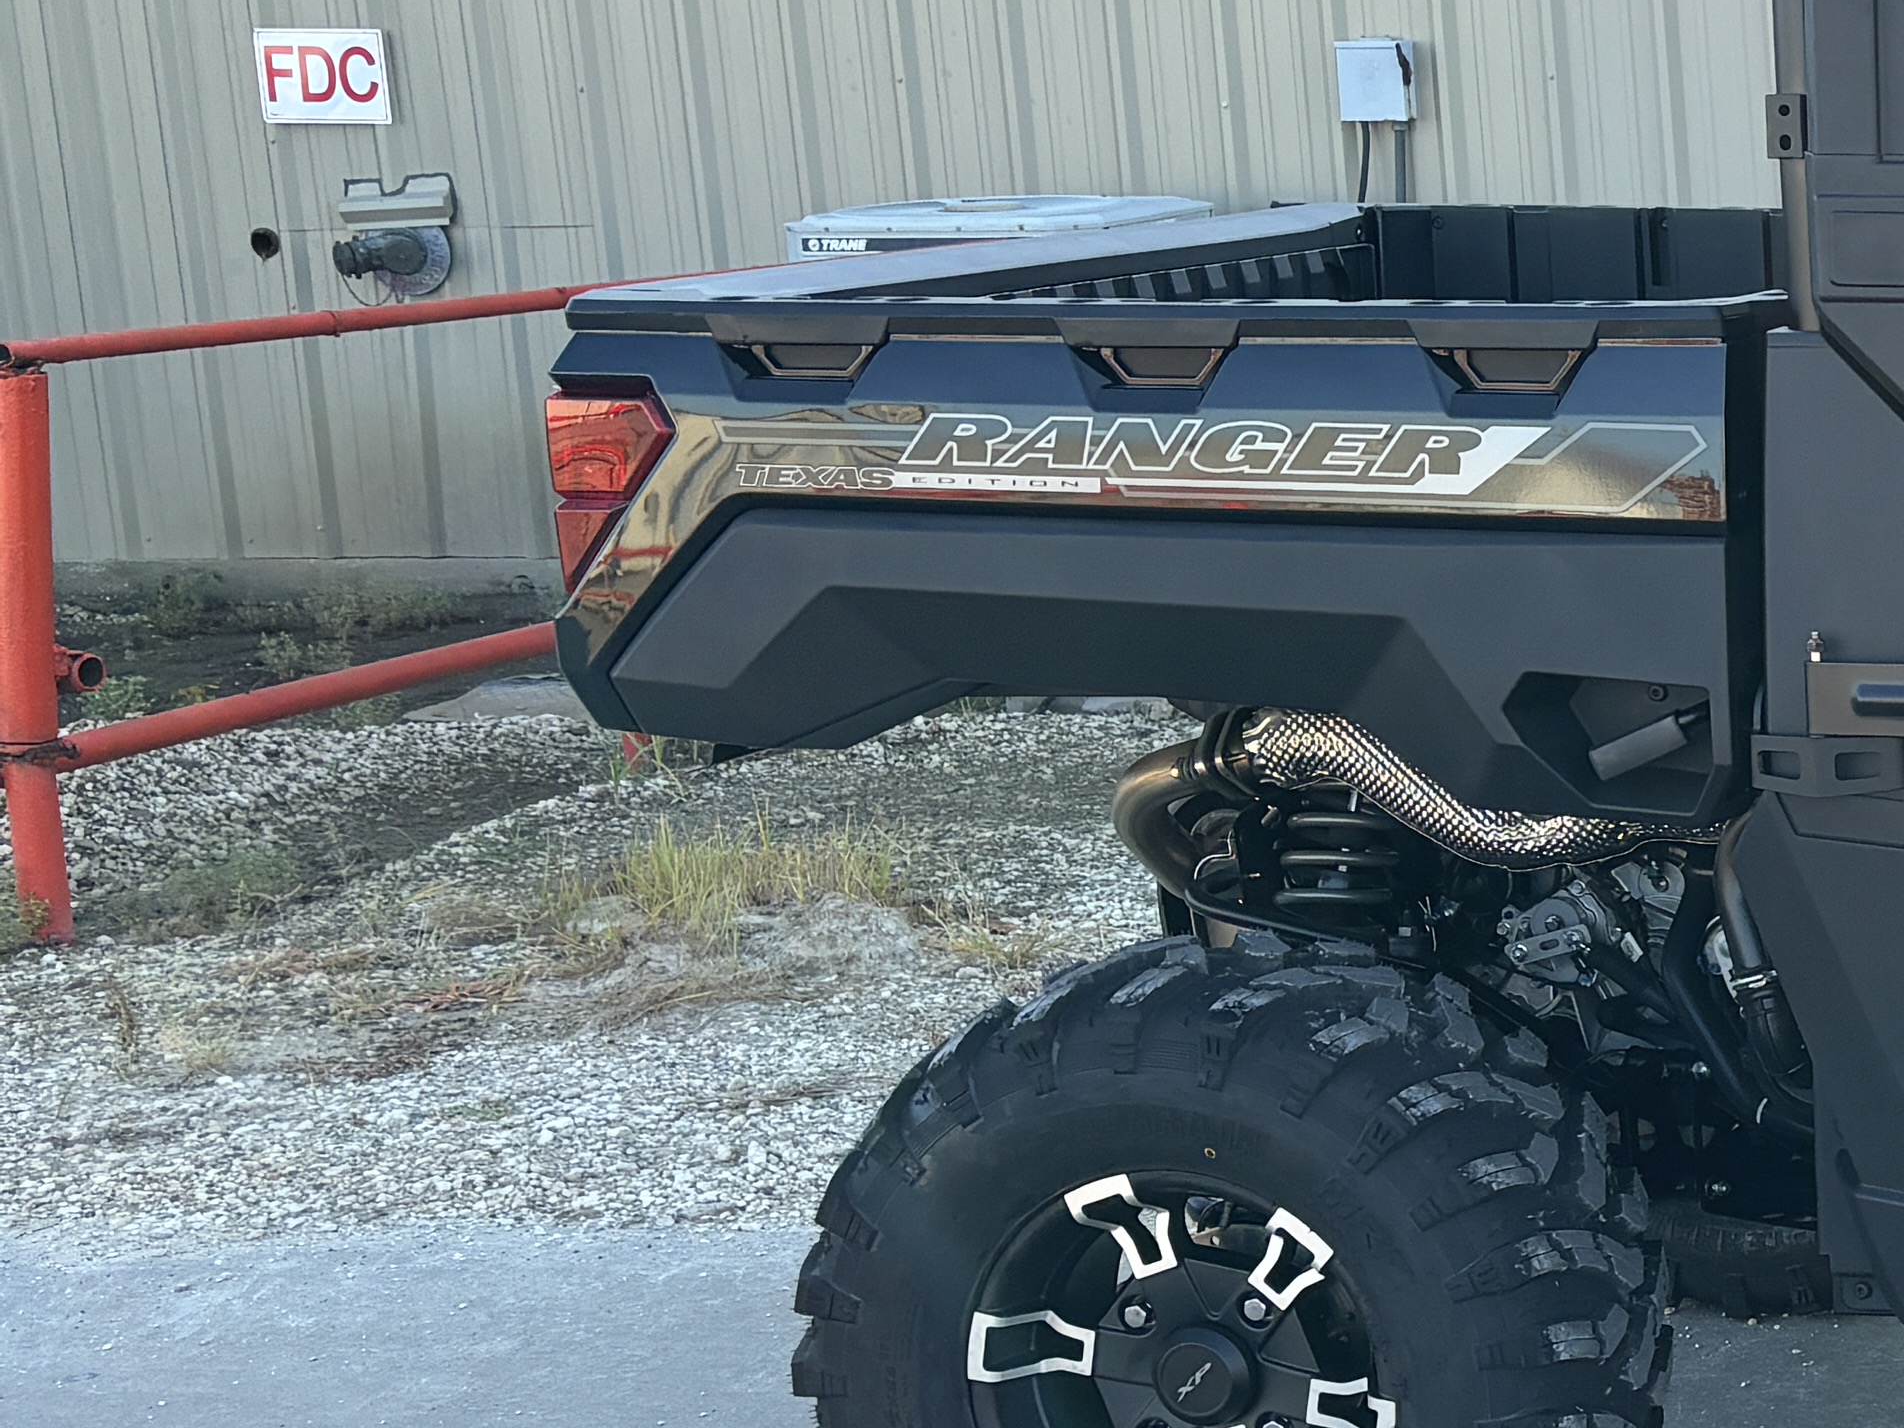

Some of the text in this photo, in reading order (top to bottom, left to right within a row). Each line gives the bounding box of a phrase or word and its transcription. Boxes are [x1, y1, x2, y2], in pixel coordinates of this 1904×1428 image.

[263, 45, 380, 103] FDC
[821, 239, 867, 251] TRANE
[897, 411, 1488, 481] RANGER
[733, 463, 1081, 491] TEXAS EDITION
[1177, 1362, 1212, 1404] XP
